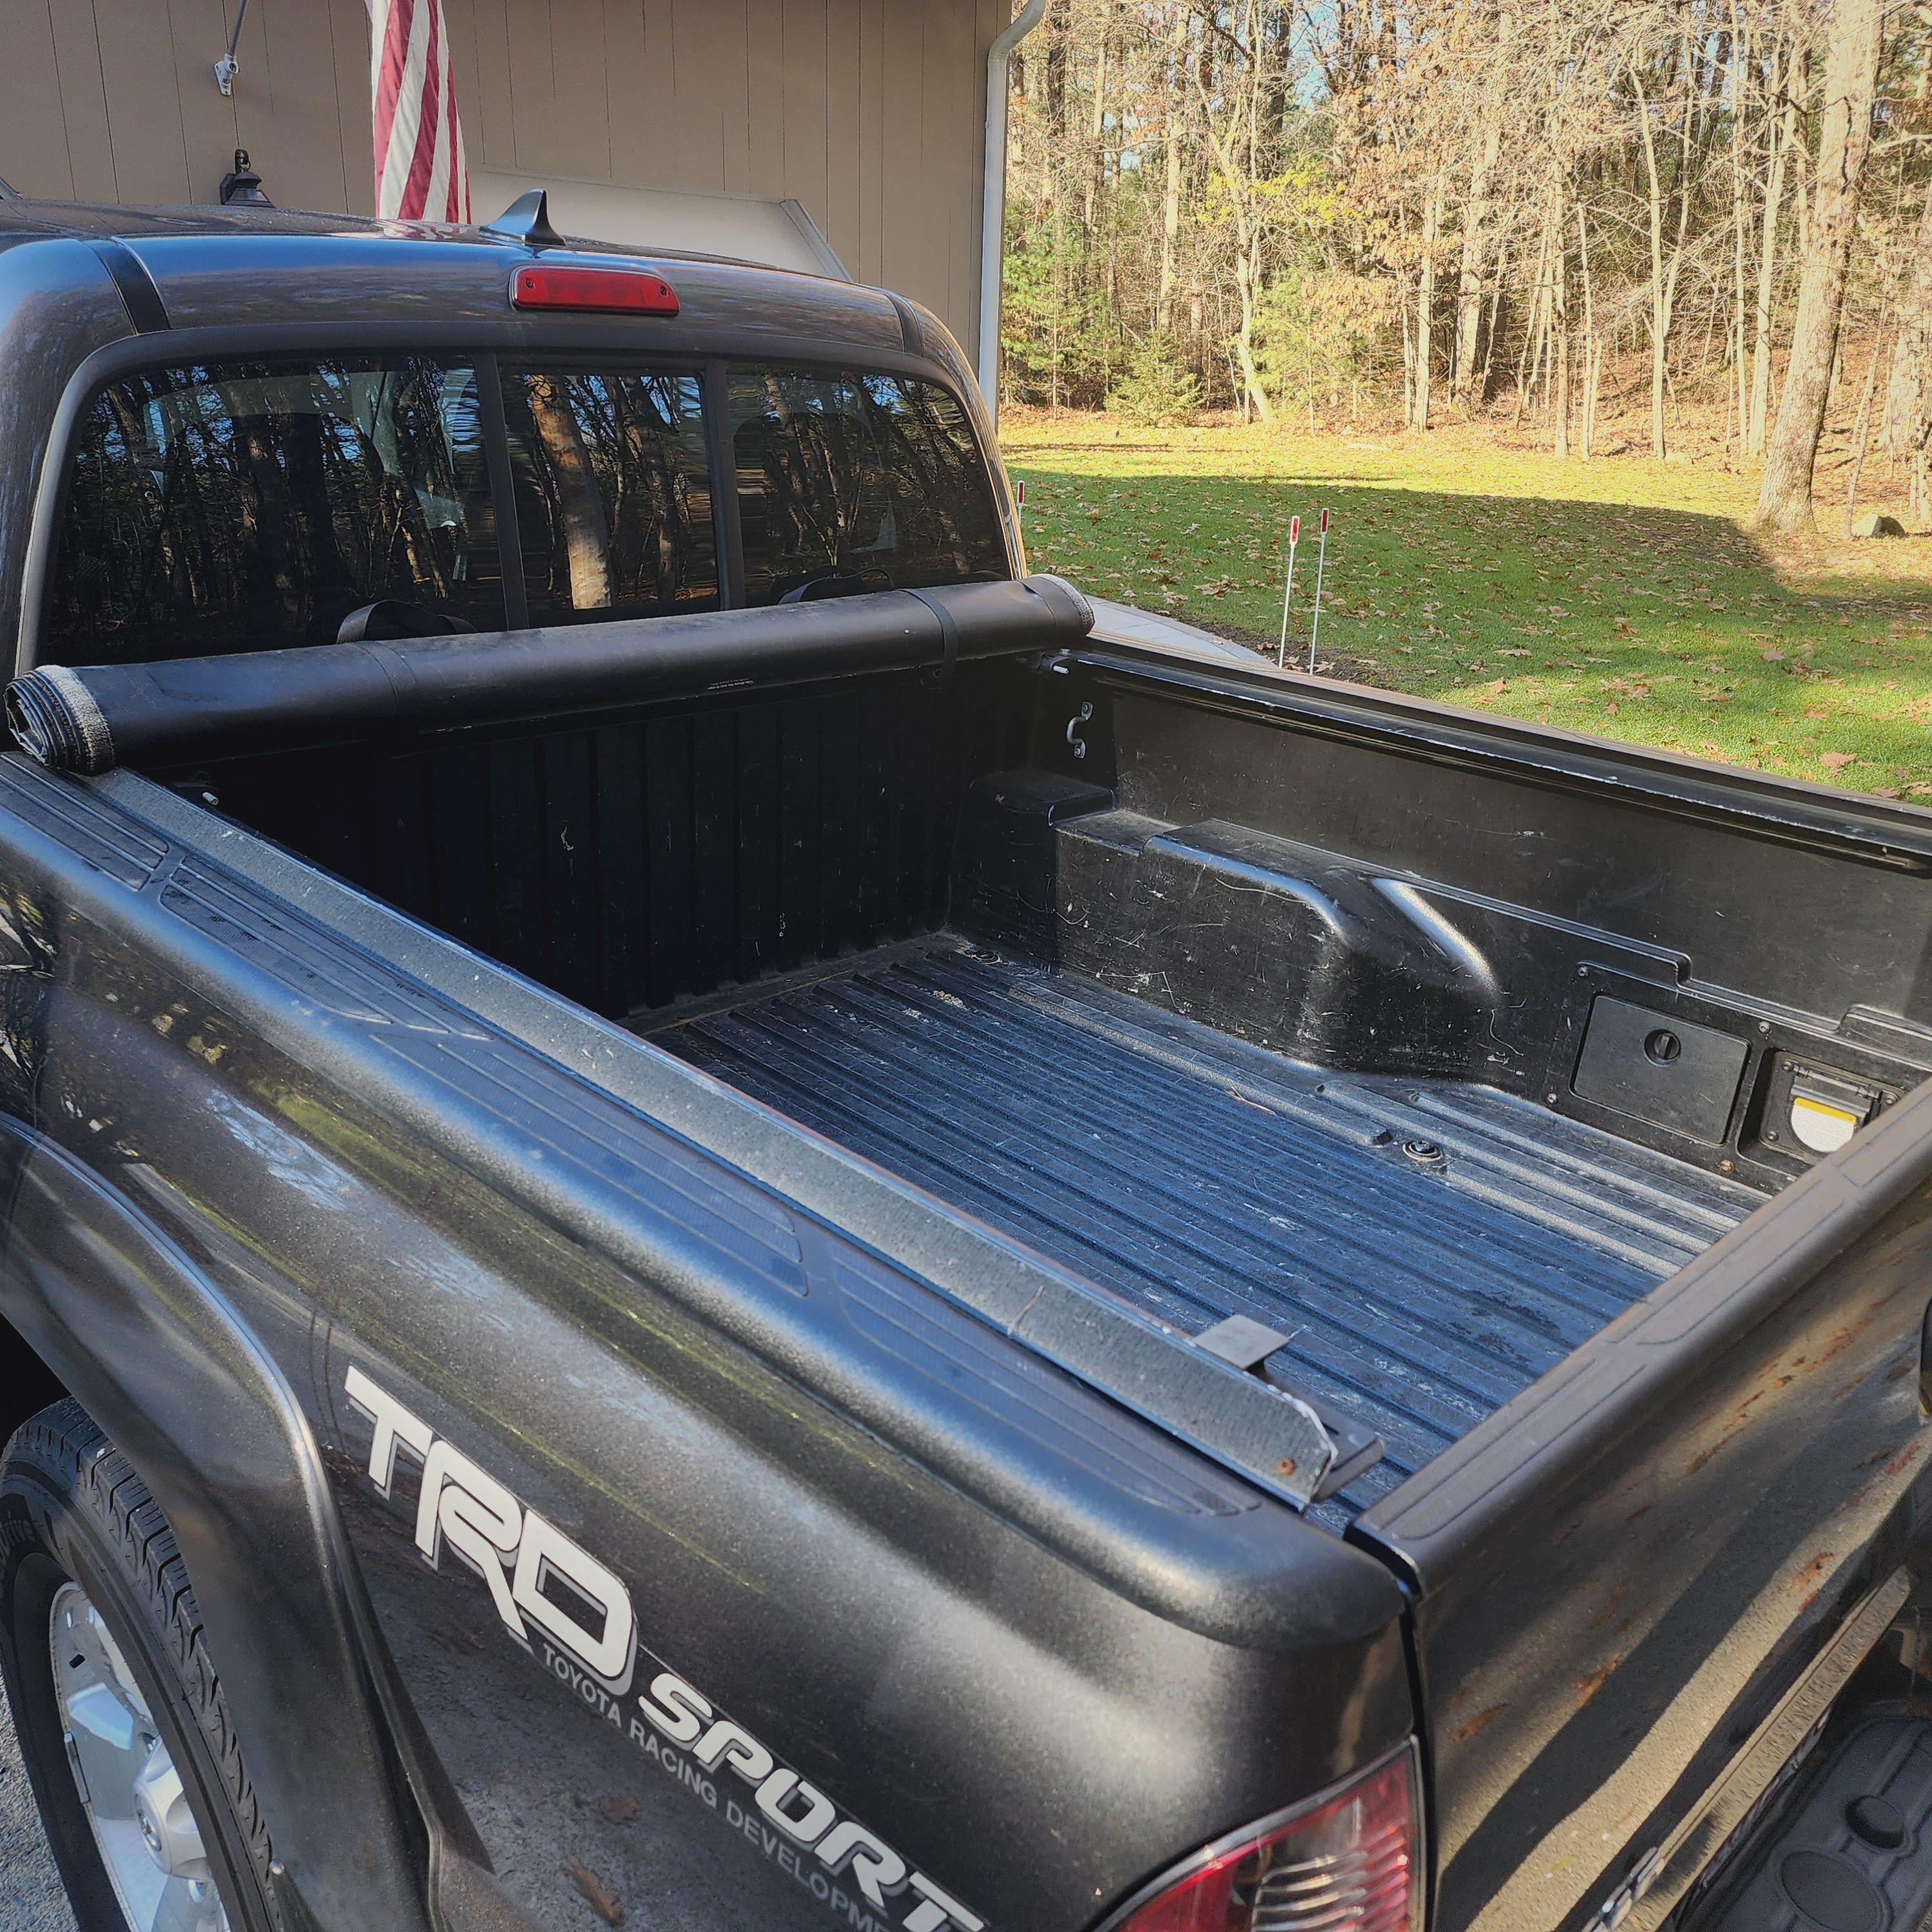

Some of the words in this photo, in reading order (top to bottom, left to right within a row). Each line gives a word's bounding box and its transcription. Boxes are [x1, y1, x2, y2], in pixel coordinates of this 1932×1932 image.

[344, 1366, 638, 1694] TRD
[638, 1673, 984, 1932] SPORT
[544, 1643, 622, 1728] TOYOTA
[630, 1718, 717, 1809] RACING
